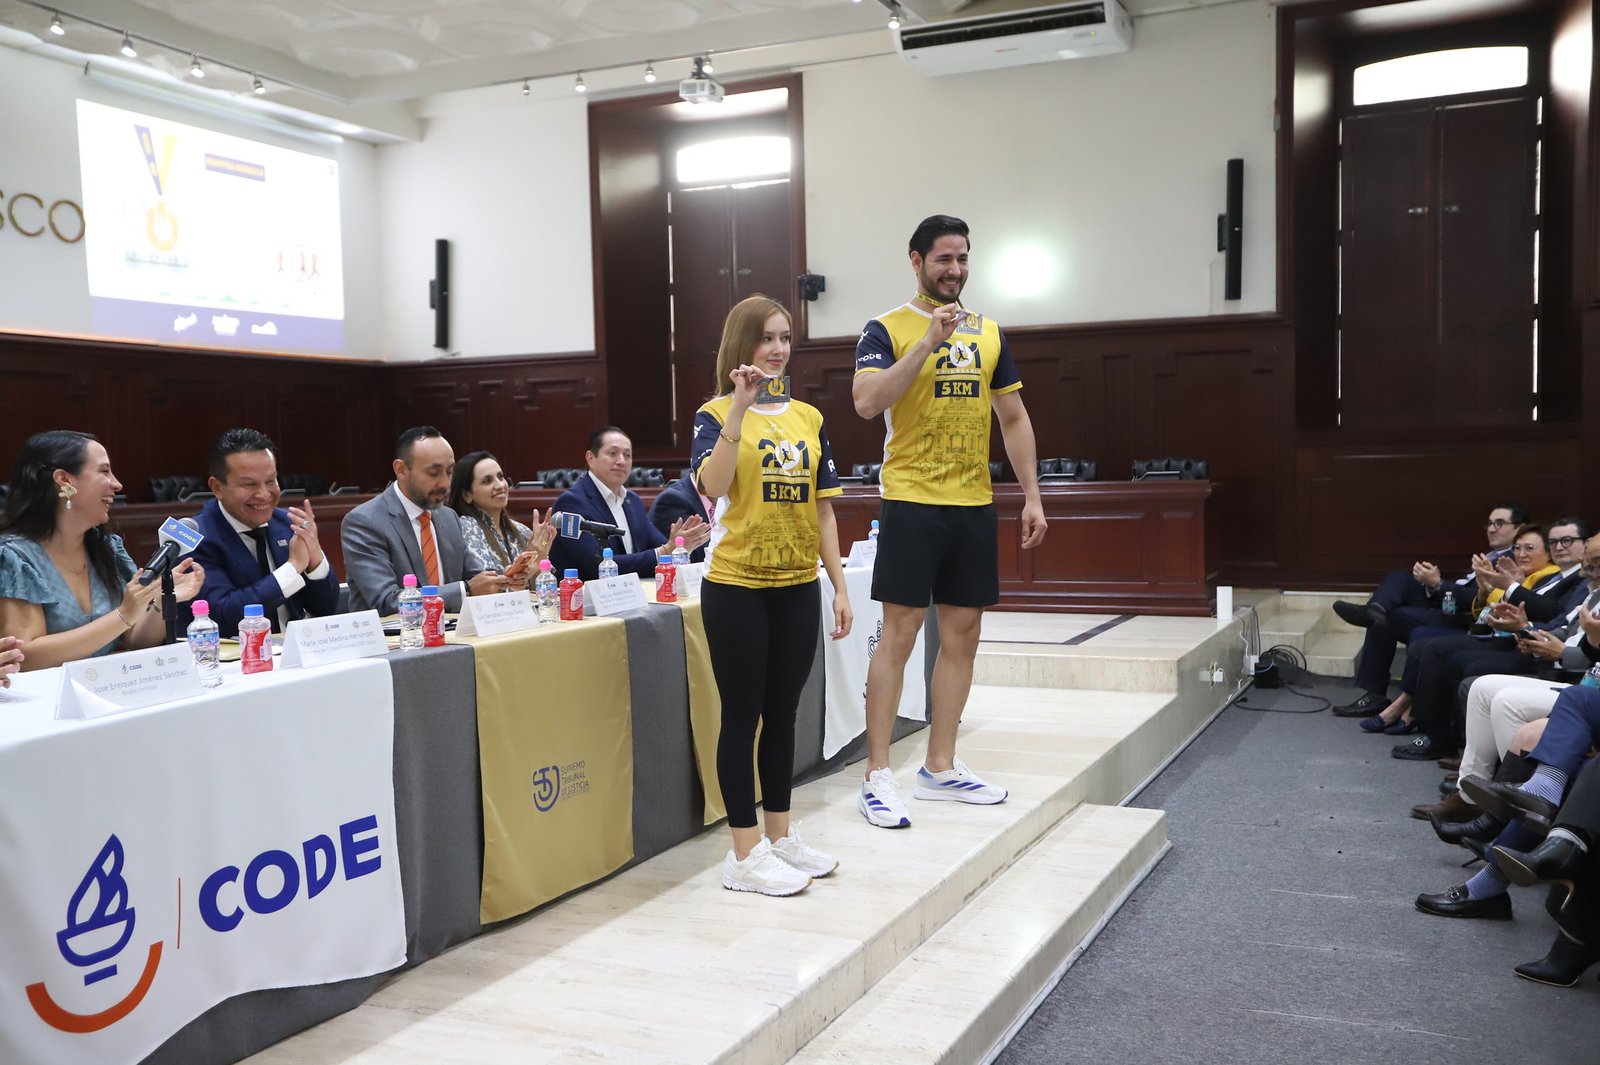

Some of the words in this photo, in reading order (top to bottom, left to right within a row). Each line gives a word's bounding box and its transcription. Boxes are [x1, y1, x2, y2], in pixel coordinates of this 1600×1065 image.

[0, 189, 86, 243] CO
[942, 382, 951, 395] 5
[953, 382, 973, 395] KM
[770, 483, 778, 499] 5
[779, 485, 801, 501] KM
[179, 531, 198, 543] CODE
[561, 760, 586, 776] SUPREMO
[561, 771, 586, 785] TRIBUNAL
[199, 815, 381, 932] CODE
